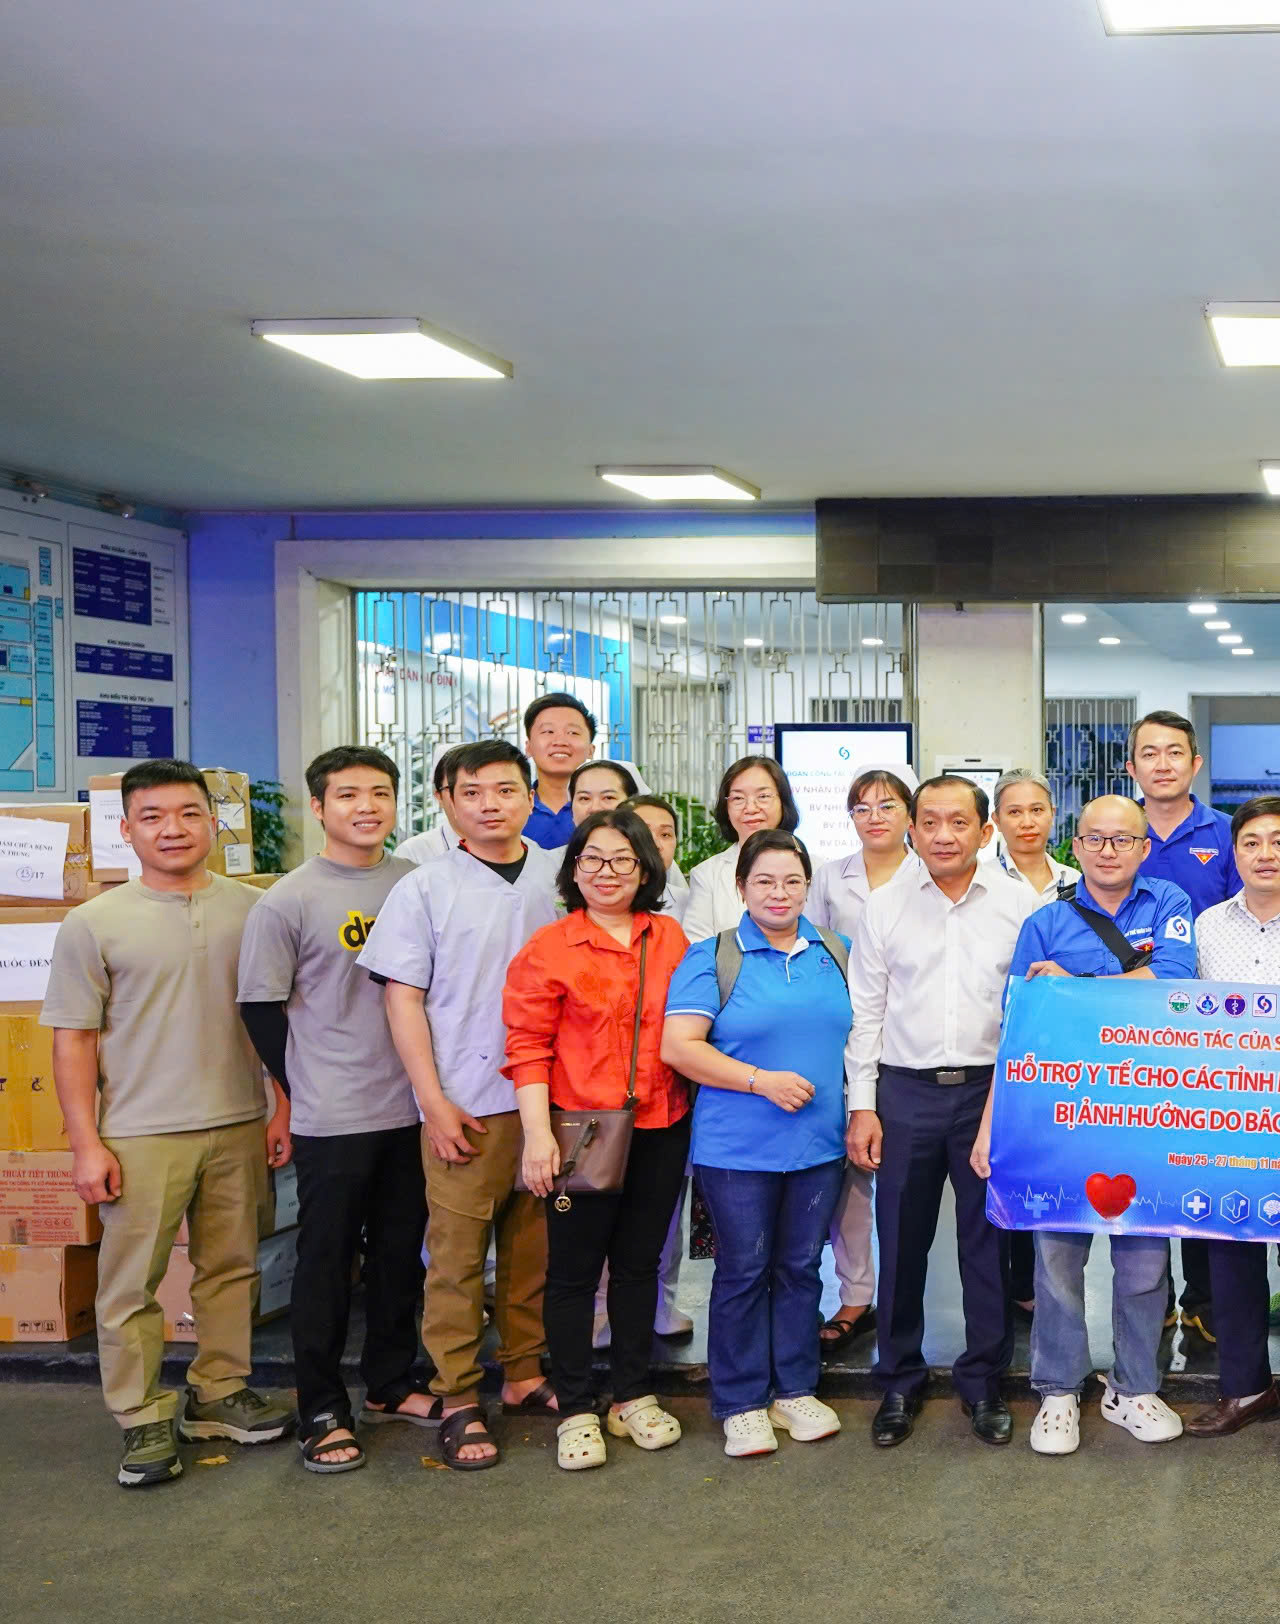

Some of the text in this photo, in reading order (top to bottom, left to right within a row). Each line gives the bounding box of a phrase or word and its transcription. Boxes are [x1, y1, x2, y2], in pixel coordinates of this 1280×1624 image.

[1100, 1026, 1150, 1045] ĐOÀN
[1152, 1027, 1199, 1047] CÔNG
[1203, 1029, 1233, 1049] TÁC
[1238, 1031, 1272, 1051] CỦA
[1006, 1053, 1037, 1083] HỖ
[1038, 1061, 1082, 1089] TRỢ
[1087, 1064, 1103, 1085] Y
[1106, 1058, 1131, 1087] TẾ
[1133, 1066, 1179, 1089] CHO
[1182, 1064, 1224, 1090] CÁC
[1223, 1065, 1274, 1093] TỈNH
[1055, 1102, 1076, 1129] BỊ
[1077, 1097, 1124, 1126] ẢNH
[1127, 1099, 1206, 1130] HƯỞNG
[1208, 1109, 1242, 1132] DO
[1168, 1153, 1193, 1166] Ngày
[1194, 1154, 1208, 1167] 25
[1228, 1156, 1258, 1170] tháng
[1259, 1157, 1270, 1169] 11
